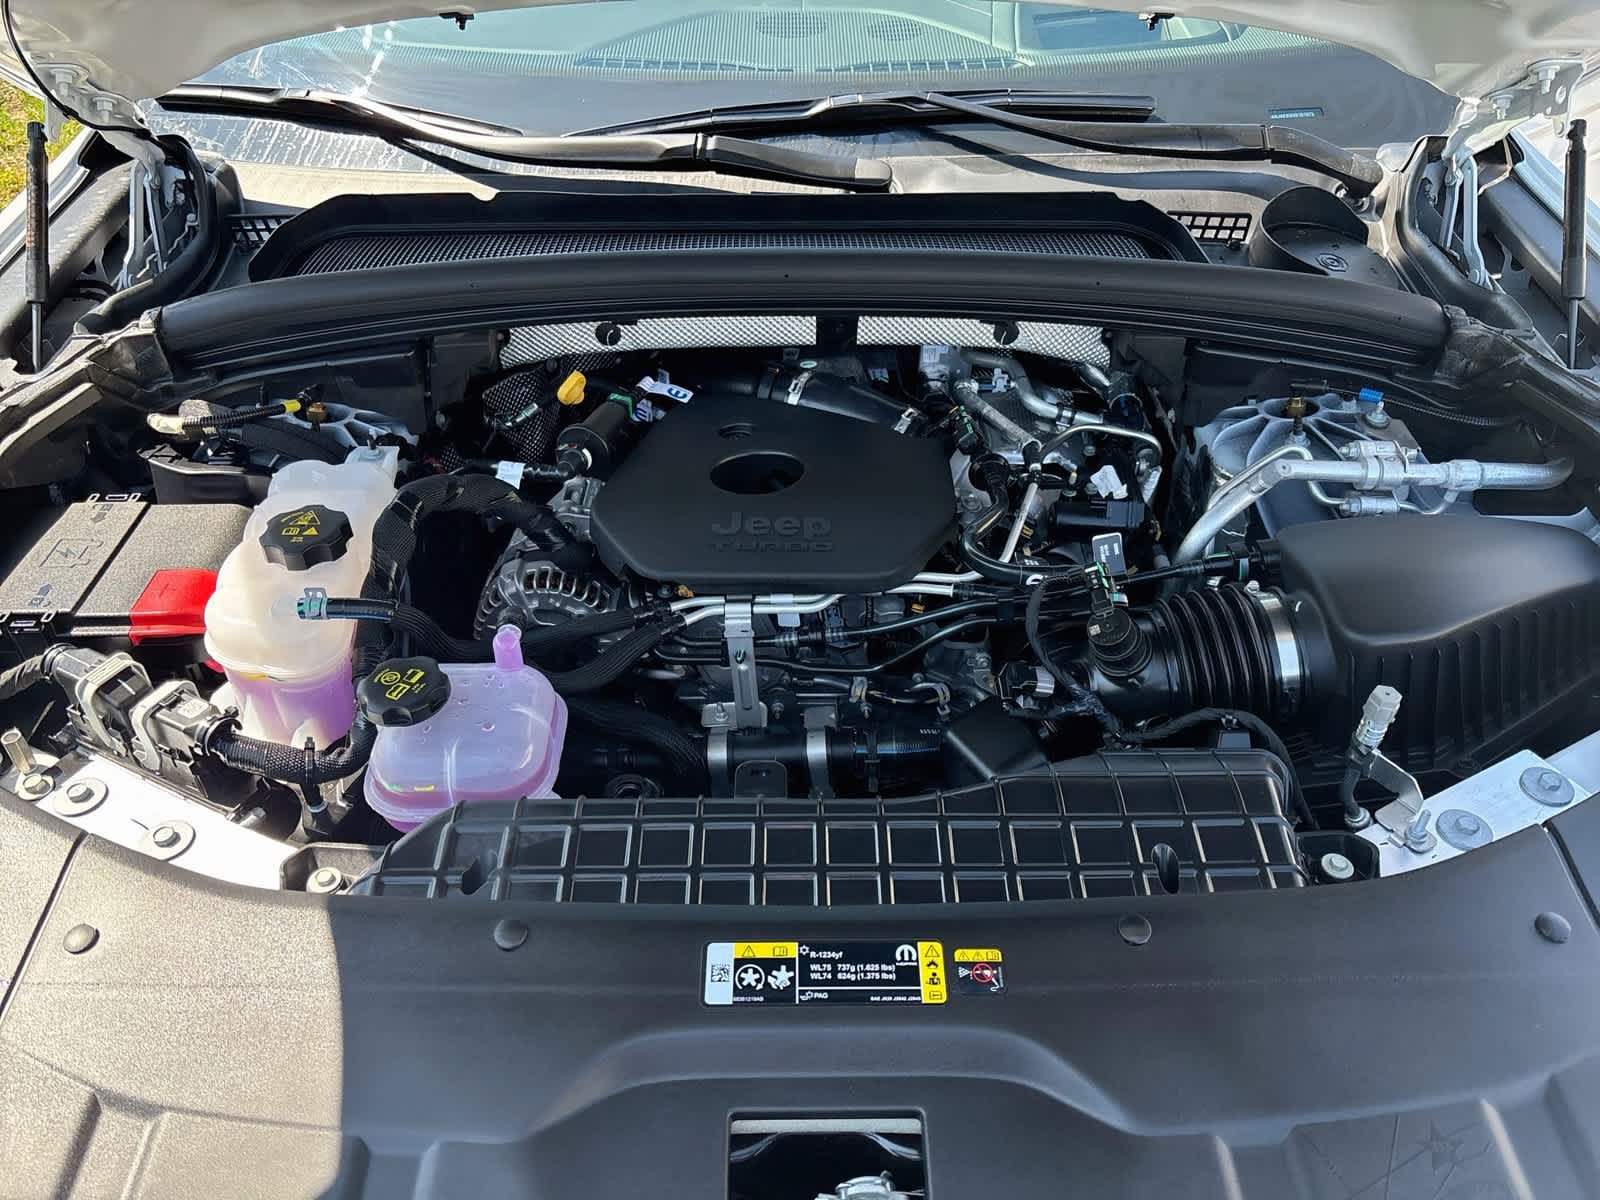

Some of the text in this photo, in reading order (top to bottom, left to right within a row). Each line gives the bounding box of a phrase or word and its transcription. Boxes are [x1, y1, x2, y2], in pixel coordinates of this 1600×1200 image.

[711, 511, 832, 542] Jeep
[809, 951, 843, 960] R-1234yf
[809, 963, 896, 973] WL75 737g (1.625 lbs)
[809, 972, 897, 981] WL74 624g (1.375 lbs)
[813, 991, 829, 999] PAG
